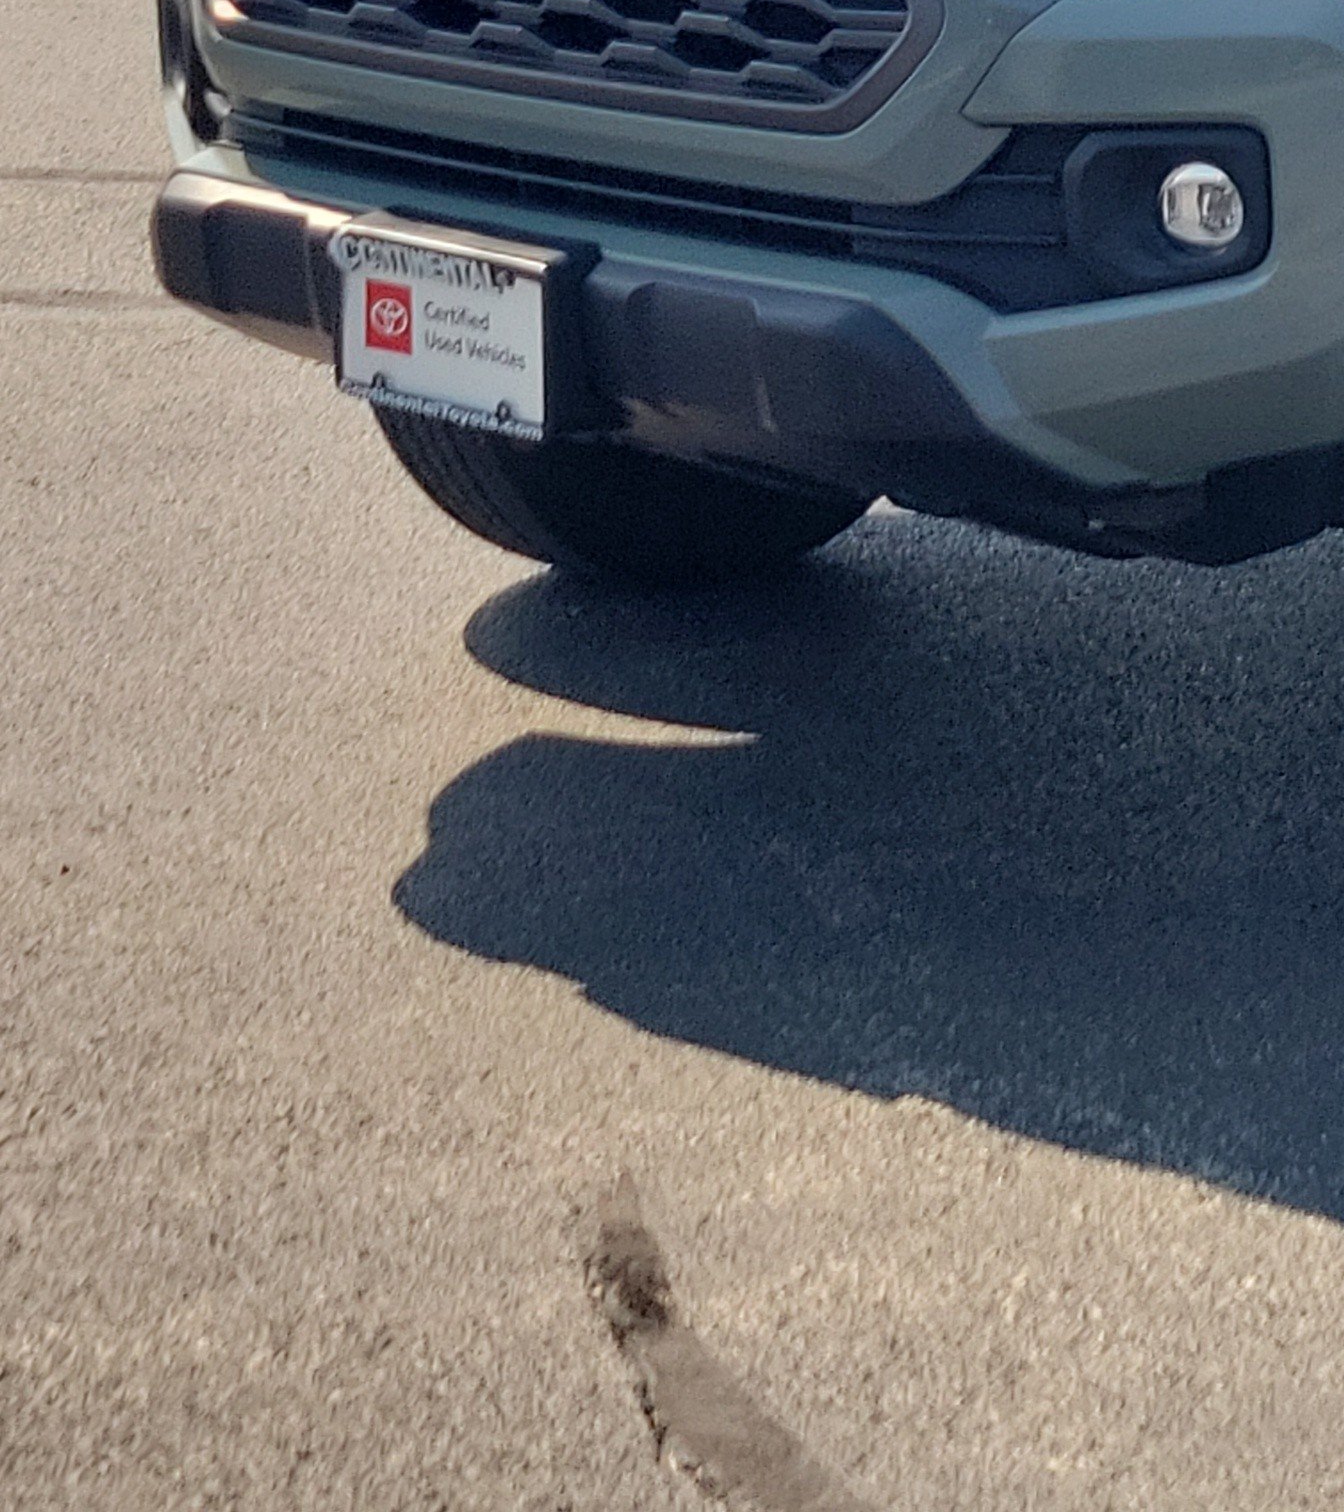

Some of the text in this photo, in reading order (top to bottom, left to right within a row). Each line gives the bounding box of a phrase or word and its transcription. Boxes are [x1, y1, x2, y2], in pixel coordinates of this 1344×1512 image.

[423, 300, 491, 332] Certified
[423, 327, 528, 372] Used Vehicles
